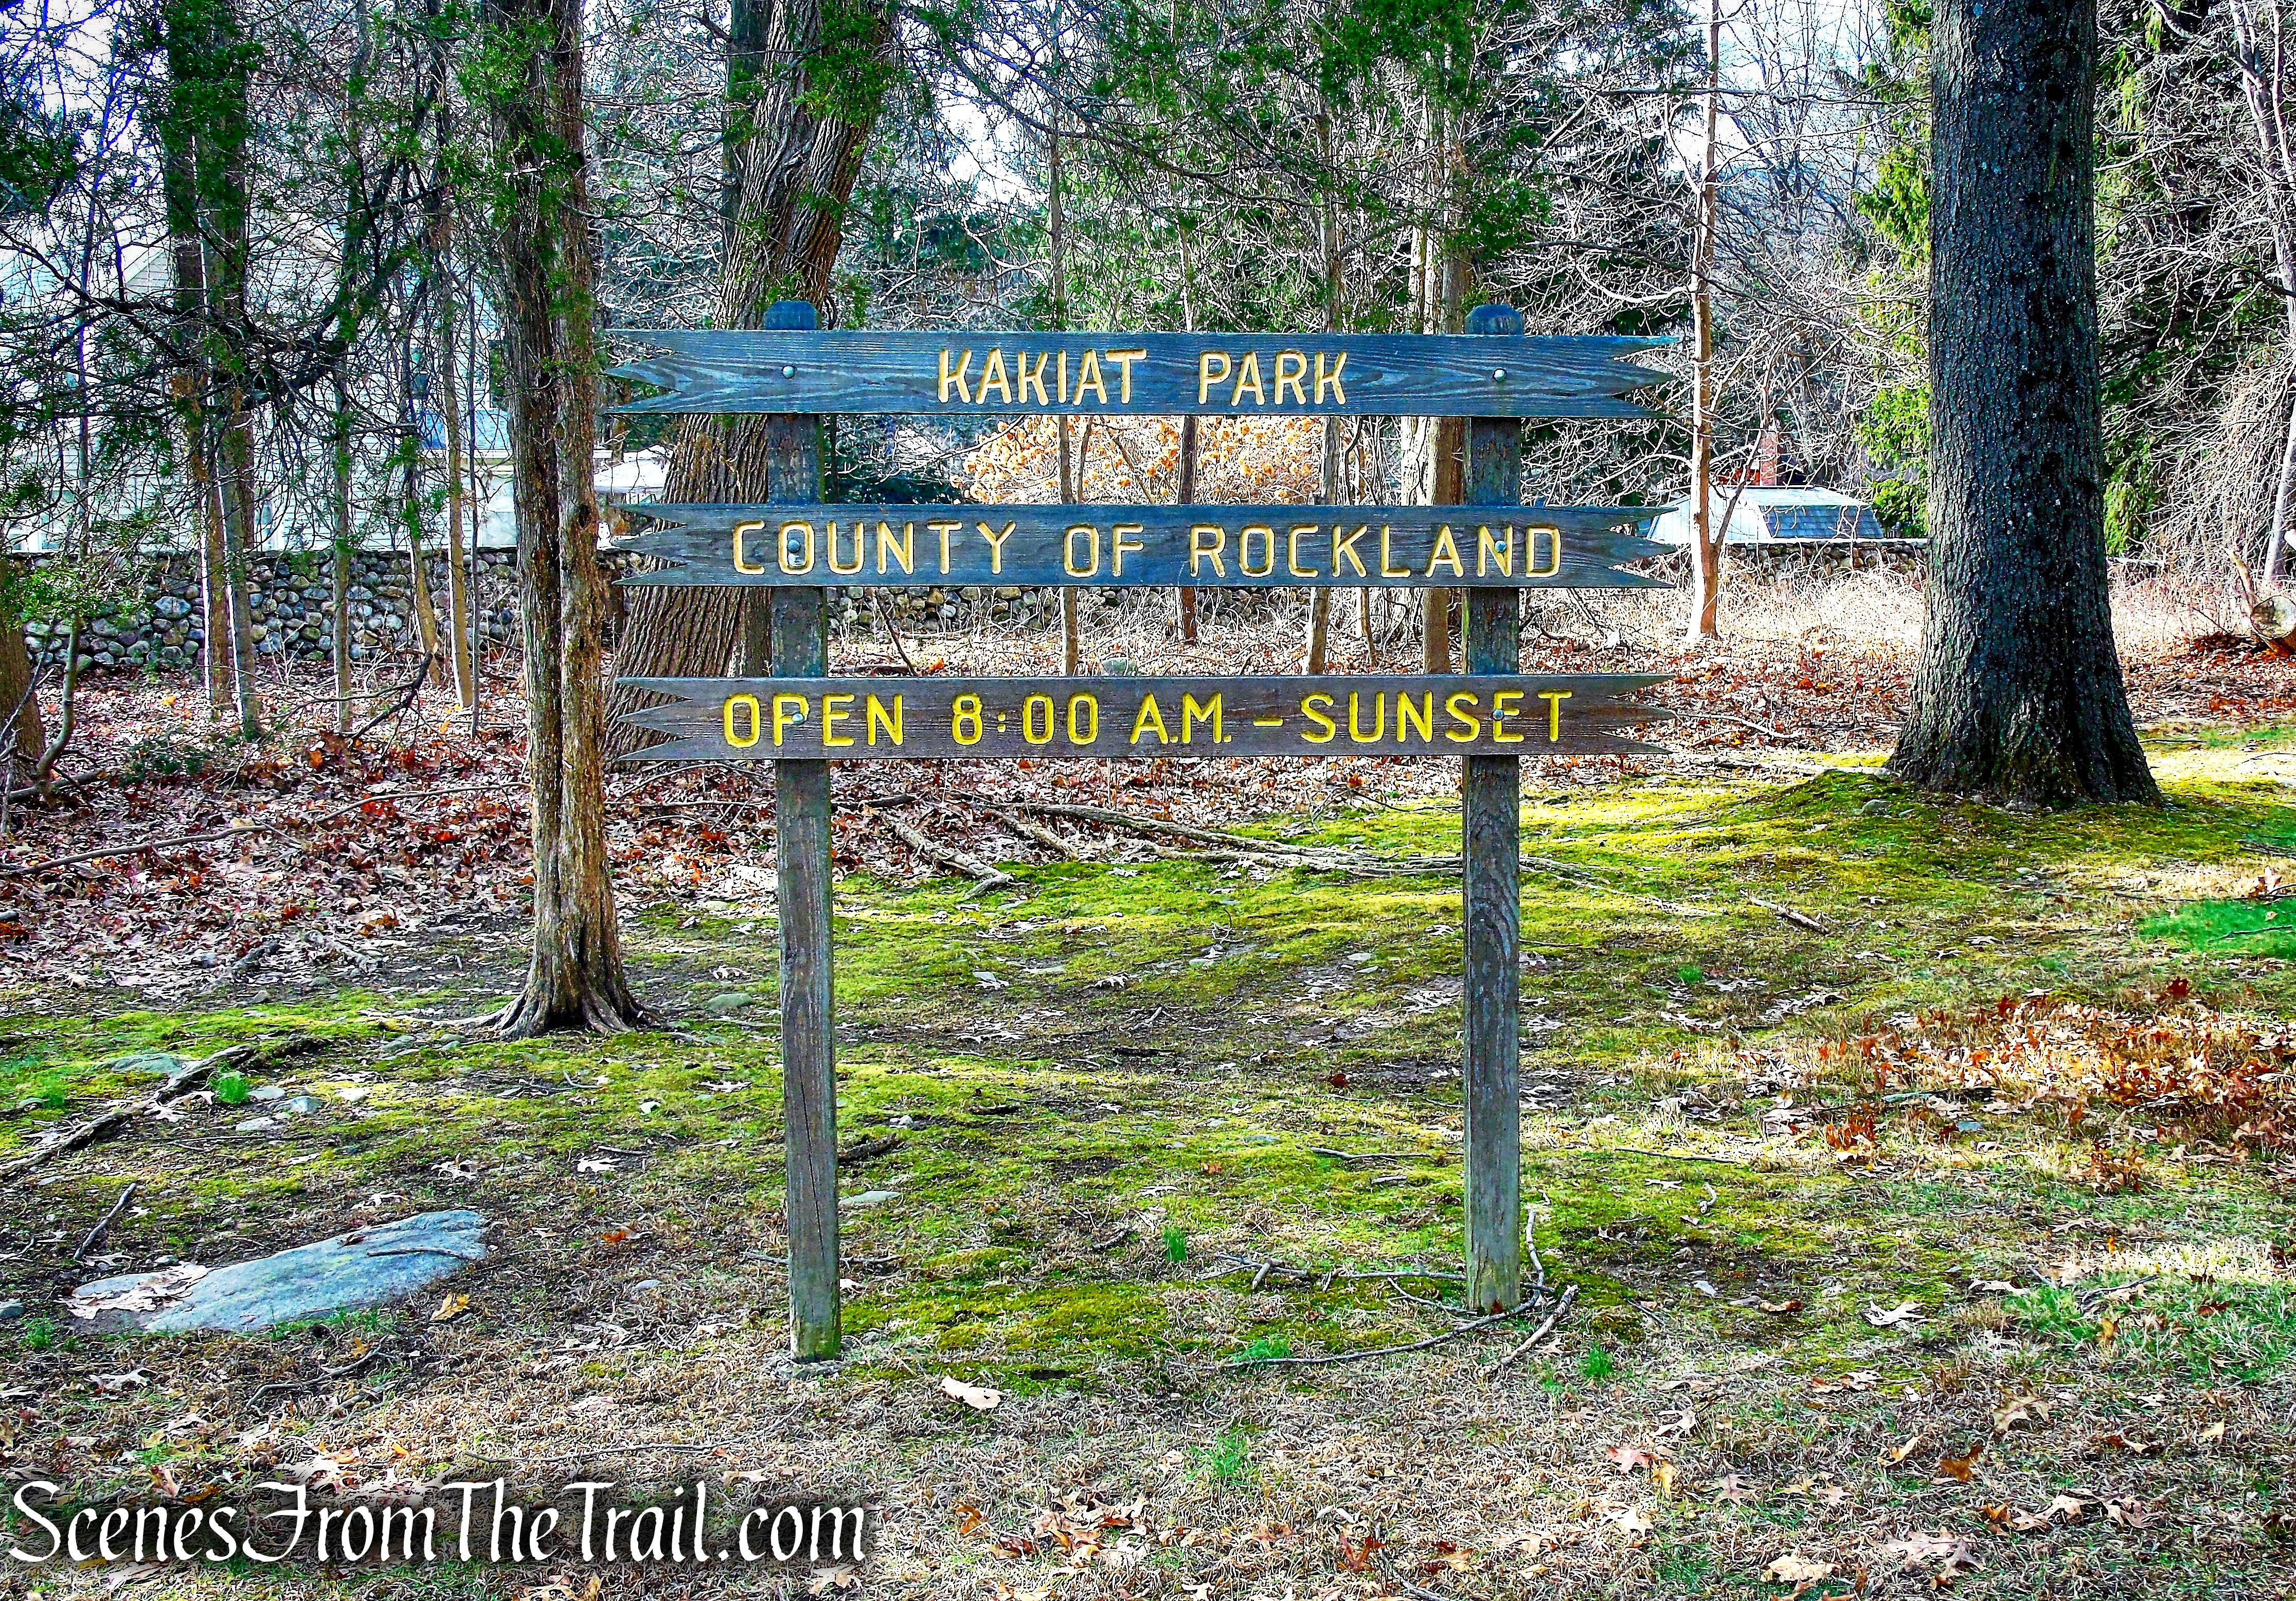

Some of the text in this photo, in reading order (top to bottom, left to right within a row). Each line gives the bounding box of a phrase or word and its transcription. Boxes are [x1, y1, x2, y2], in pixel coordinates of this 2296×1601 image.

[937, 348, 1349, 405] KAKIAT PARK
[732, 520, 1562, 578] COUNTY OF ROCKLAND
[723, 692, 904, 747] OPEN
[952, 693, 1101, 745] 8:00
[1130, 692, 1233, 744] A.M.
[1301, 690, 1573, 744] SUNSET
